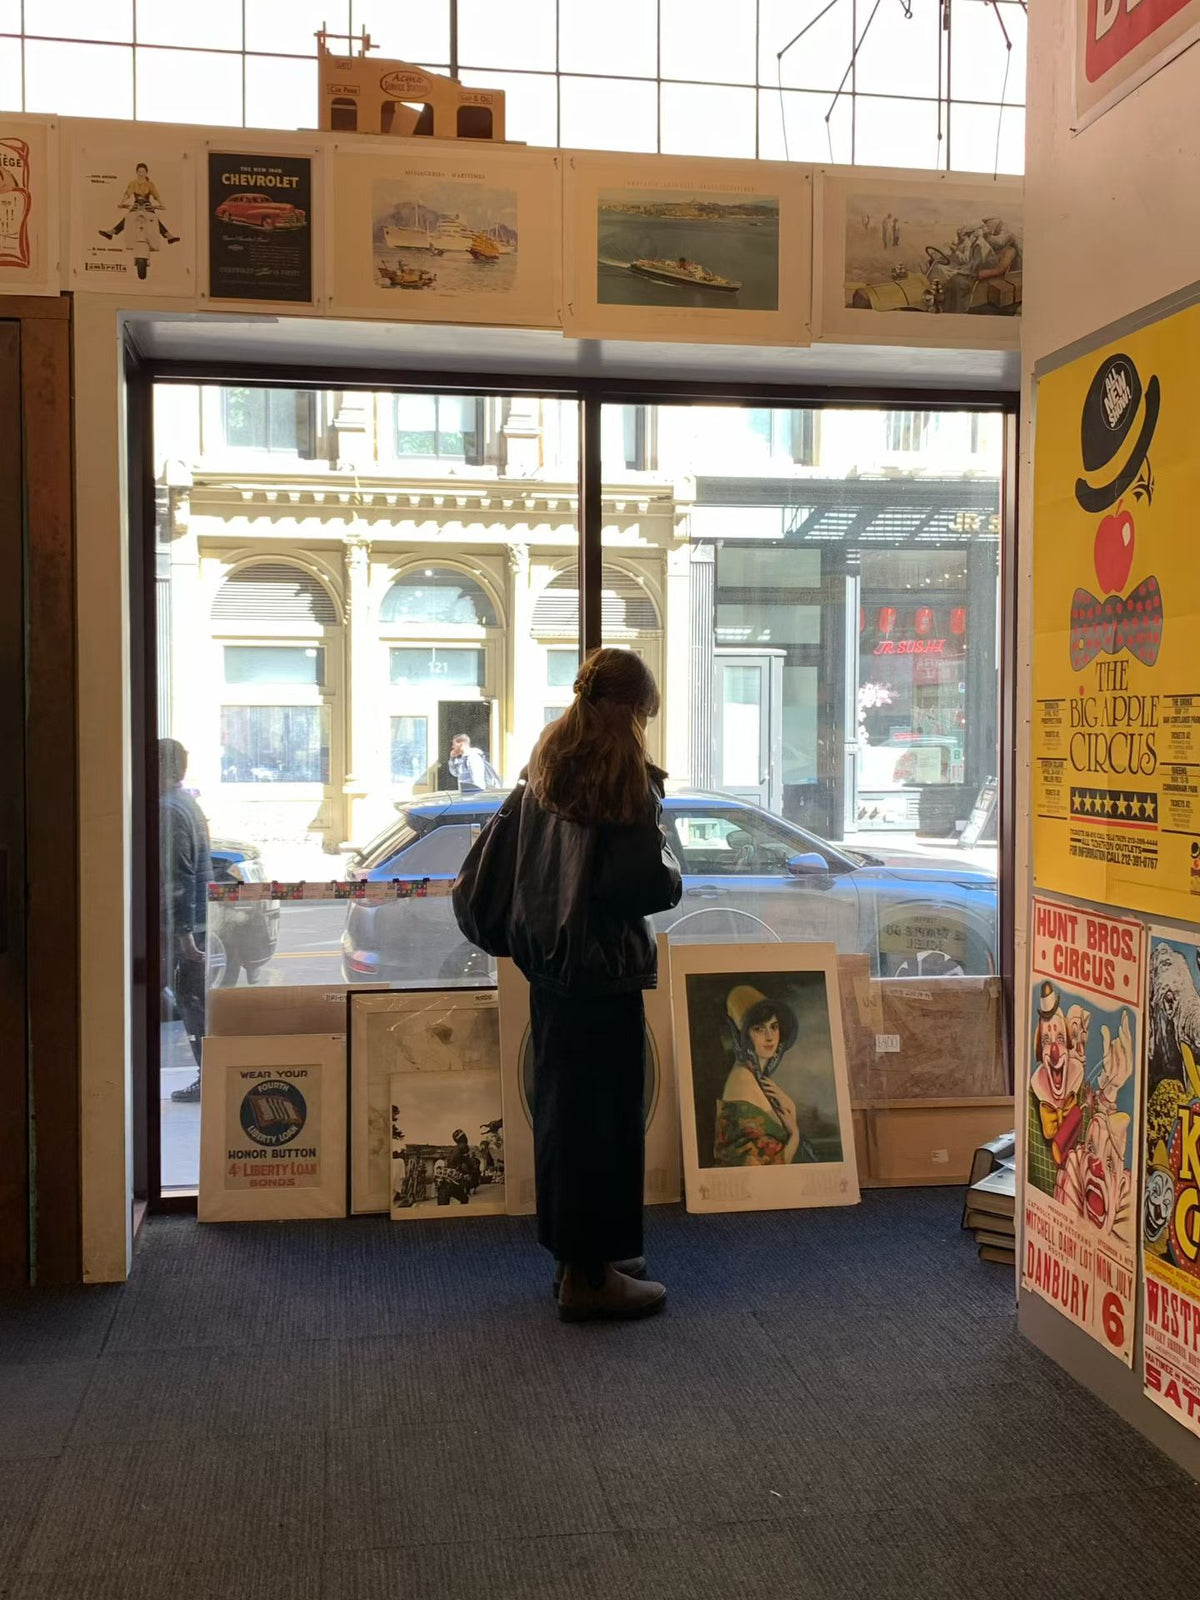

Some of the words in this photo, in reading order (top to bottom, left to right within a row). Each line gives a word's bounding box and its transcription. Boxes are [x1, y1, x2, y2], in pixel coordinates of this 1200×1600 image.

[221, 173, 299, 188] CHEVROLET
[1104, 370, 1127, 415] NEW
[1105, 367, 1118, 393] ALL
[1108, 385, 1132, 428] SHOW!
[873, 641, 896, 655] JR
[897, 639, 946, 654] SUSHI
[427, 662, 448, 673] 121
[1096, 660, 1129, 692] THE
[1070, 687, 1098, 728] BIG
[1100, 695, 1159, 728] APPLE
[1069, 731, 1157, 776] CIRCUS
[1106, 851, 1120, 864] CALL
[1115, 843, 1142, 854] OUTLETS
[1037, 907, 1078, 945] HUNT
[1087, 919, 1136, 963] BROS.
[1054, 944, 1115, 990] CIRCUS
[240, 1071, 271, 1079] WEAR
[276, 1070, 308, 1078] YOUR
[258, 1082, 290, 1093] FOURTH
[248, 1125, 277, 1143] LIBERTY
[279, 1124, 298, 1141] LOAN
[228, 1150, 267, 1160] HONOR
[271, 1148, 317, 1158] BUTTON
[244, 1163, 289, 1177] LIBERTY
[290, 1162, 317, 1176] LOAN
[250, 1178, 296, 1188] BONDS
[1053, 1216, 1063, 1228] WAR
[1026, 1208, 1055, 1246] MITCHELL
[1059, 1230, 1077, 1263] DAIRY
[1080, 1246, 1092, 1272] LOT
[1027, 1240, 1089, 1322] DANBURY
[1116, 1266, 1133, 1302] JULY
[1102, 1292, 1124, 1348] 6
[1145, 1350, 1174, 1377] MATINEE
